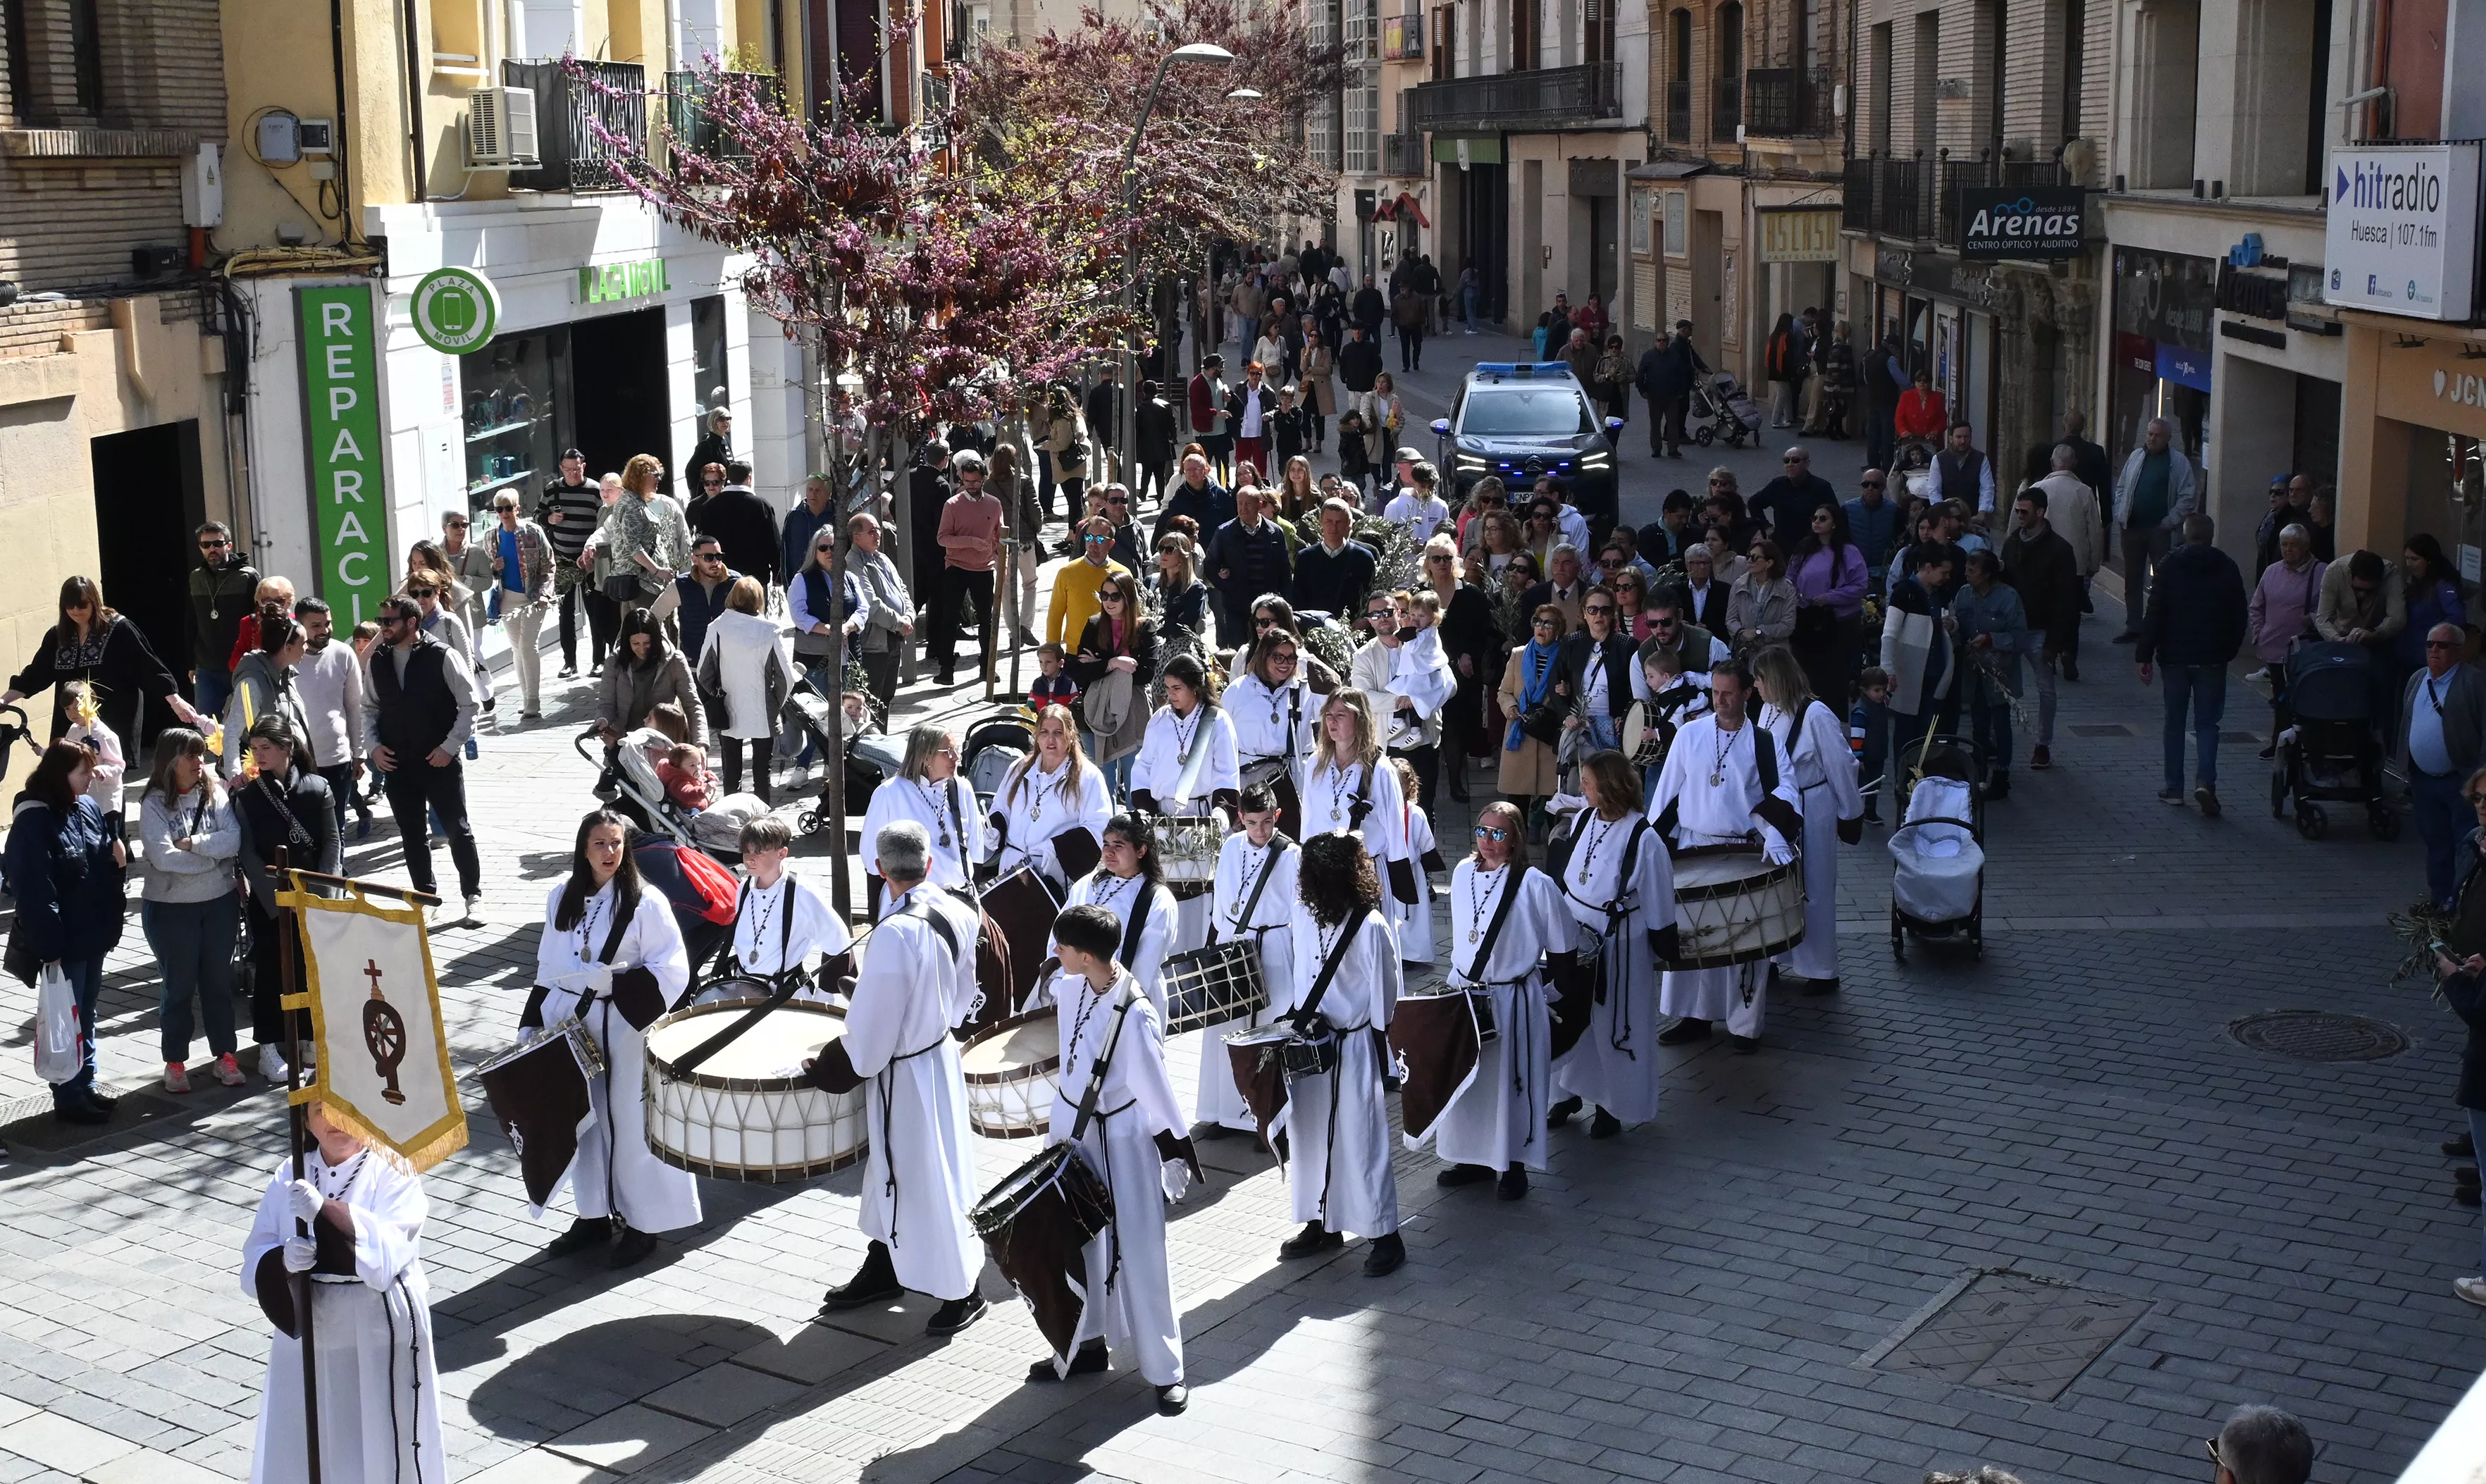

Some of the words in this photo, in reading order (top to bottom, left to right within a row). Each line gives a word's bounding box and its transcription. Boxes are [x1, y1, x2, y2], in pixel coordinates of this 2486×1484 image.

[2354, 161, 2439, 213] hitradio
[1967, 209, 2079, 237] Arenas
[2351, 220, 2387, 243] Huesca
[2397, 223, 2437, 248] 107.1fm
[1967, 241, 2000, 249] CENTRO
[2002, 238, 2032, 249] ÓPTICO
[2041, 240, 2079, 248] AUDITIVO
[428, 277, 475, 295] PLAZA
[433, 331, 474, 345] MOVIL
[321, 302, 371, 643] REPARACI
